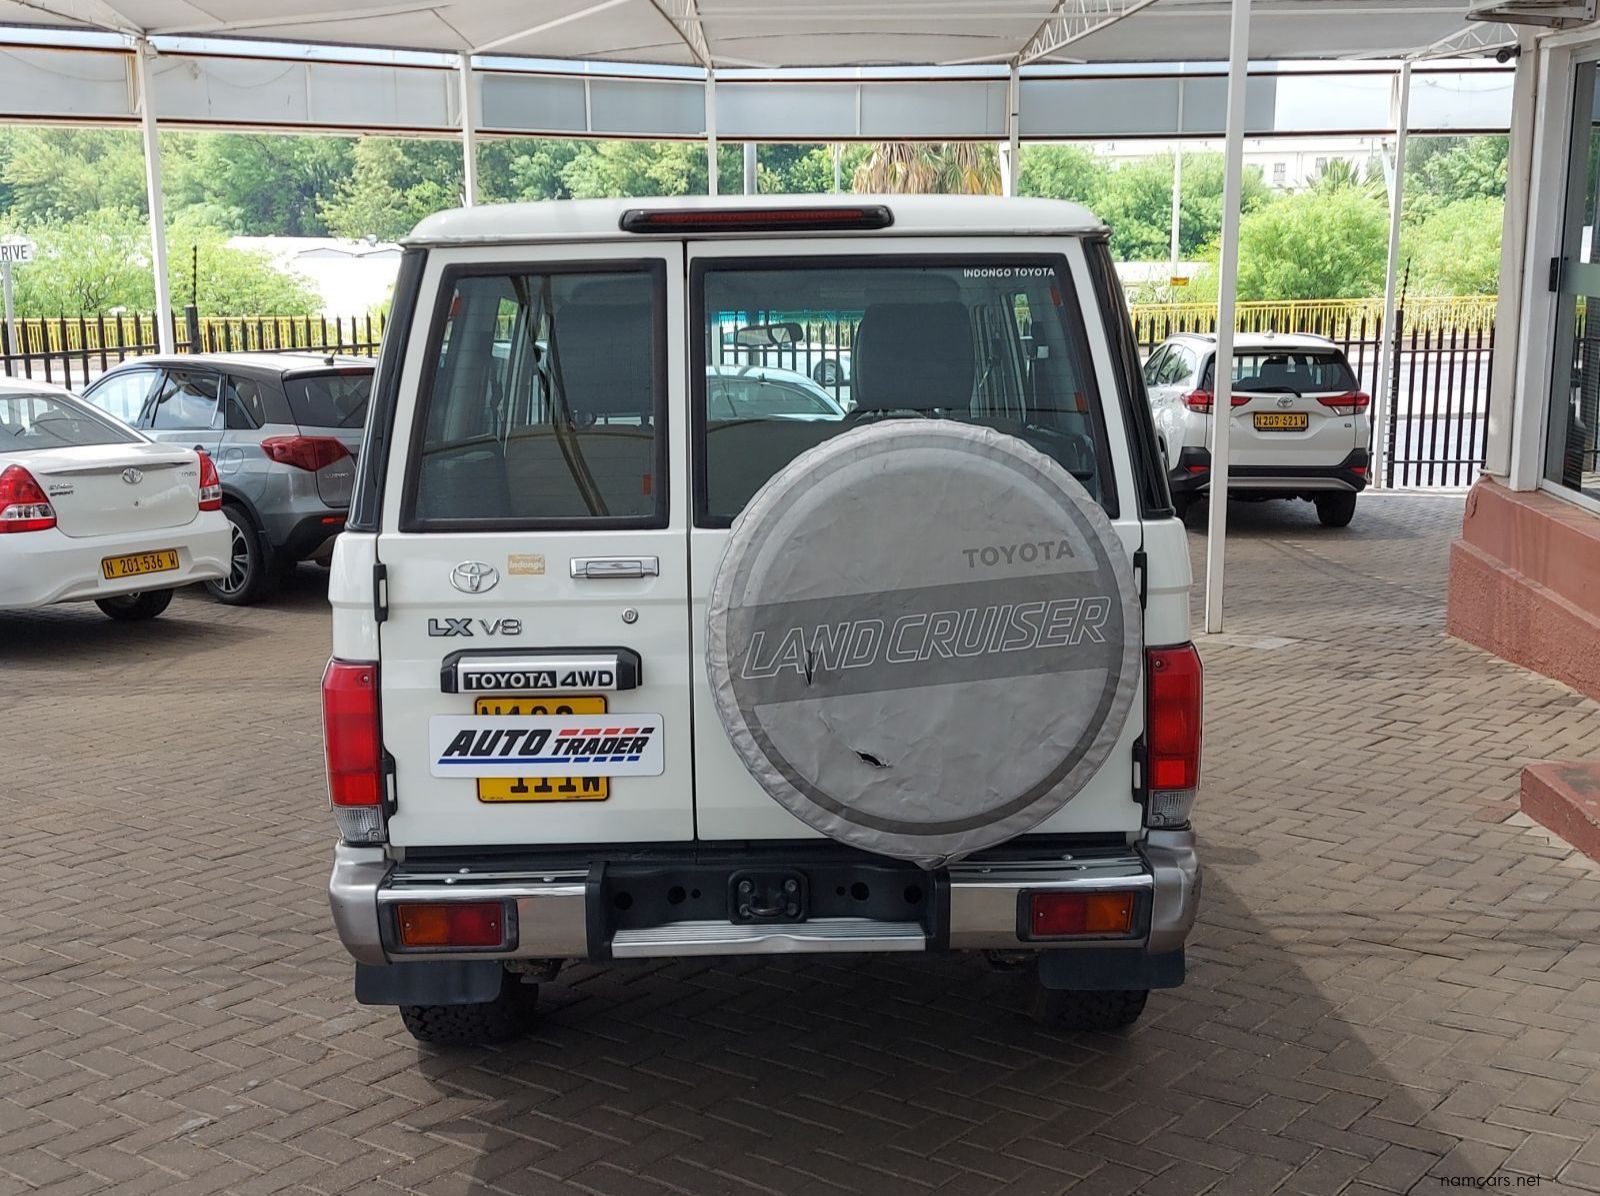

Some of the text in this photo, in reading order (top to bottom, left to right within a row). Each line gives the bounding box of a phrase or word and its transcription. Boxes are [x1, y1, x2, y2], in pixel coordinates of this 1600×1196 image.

[1, 245, 28, 261] RIVE
[963, 267, 1055, 278] INDONGO TOYOTA
[963, 539, 1075, 568] TOYOTA
[106, 561, 115, 576] N
[428, 618, 522, 637] LX V8
[741, 596, 1111, 680] LAND CRUISER
[467, 670, 614, 689] TOYOTA 4WD
[442, 729, 650, 757] AUTO TRADER
